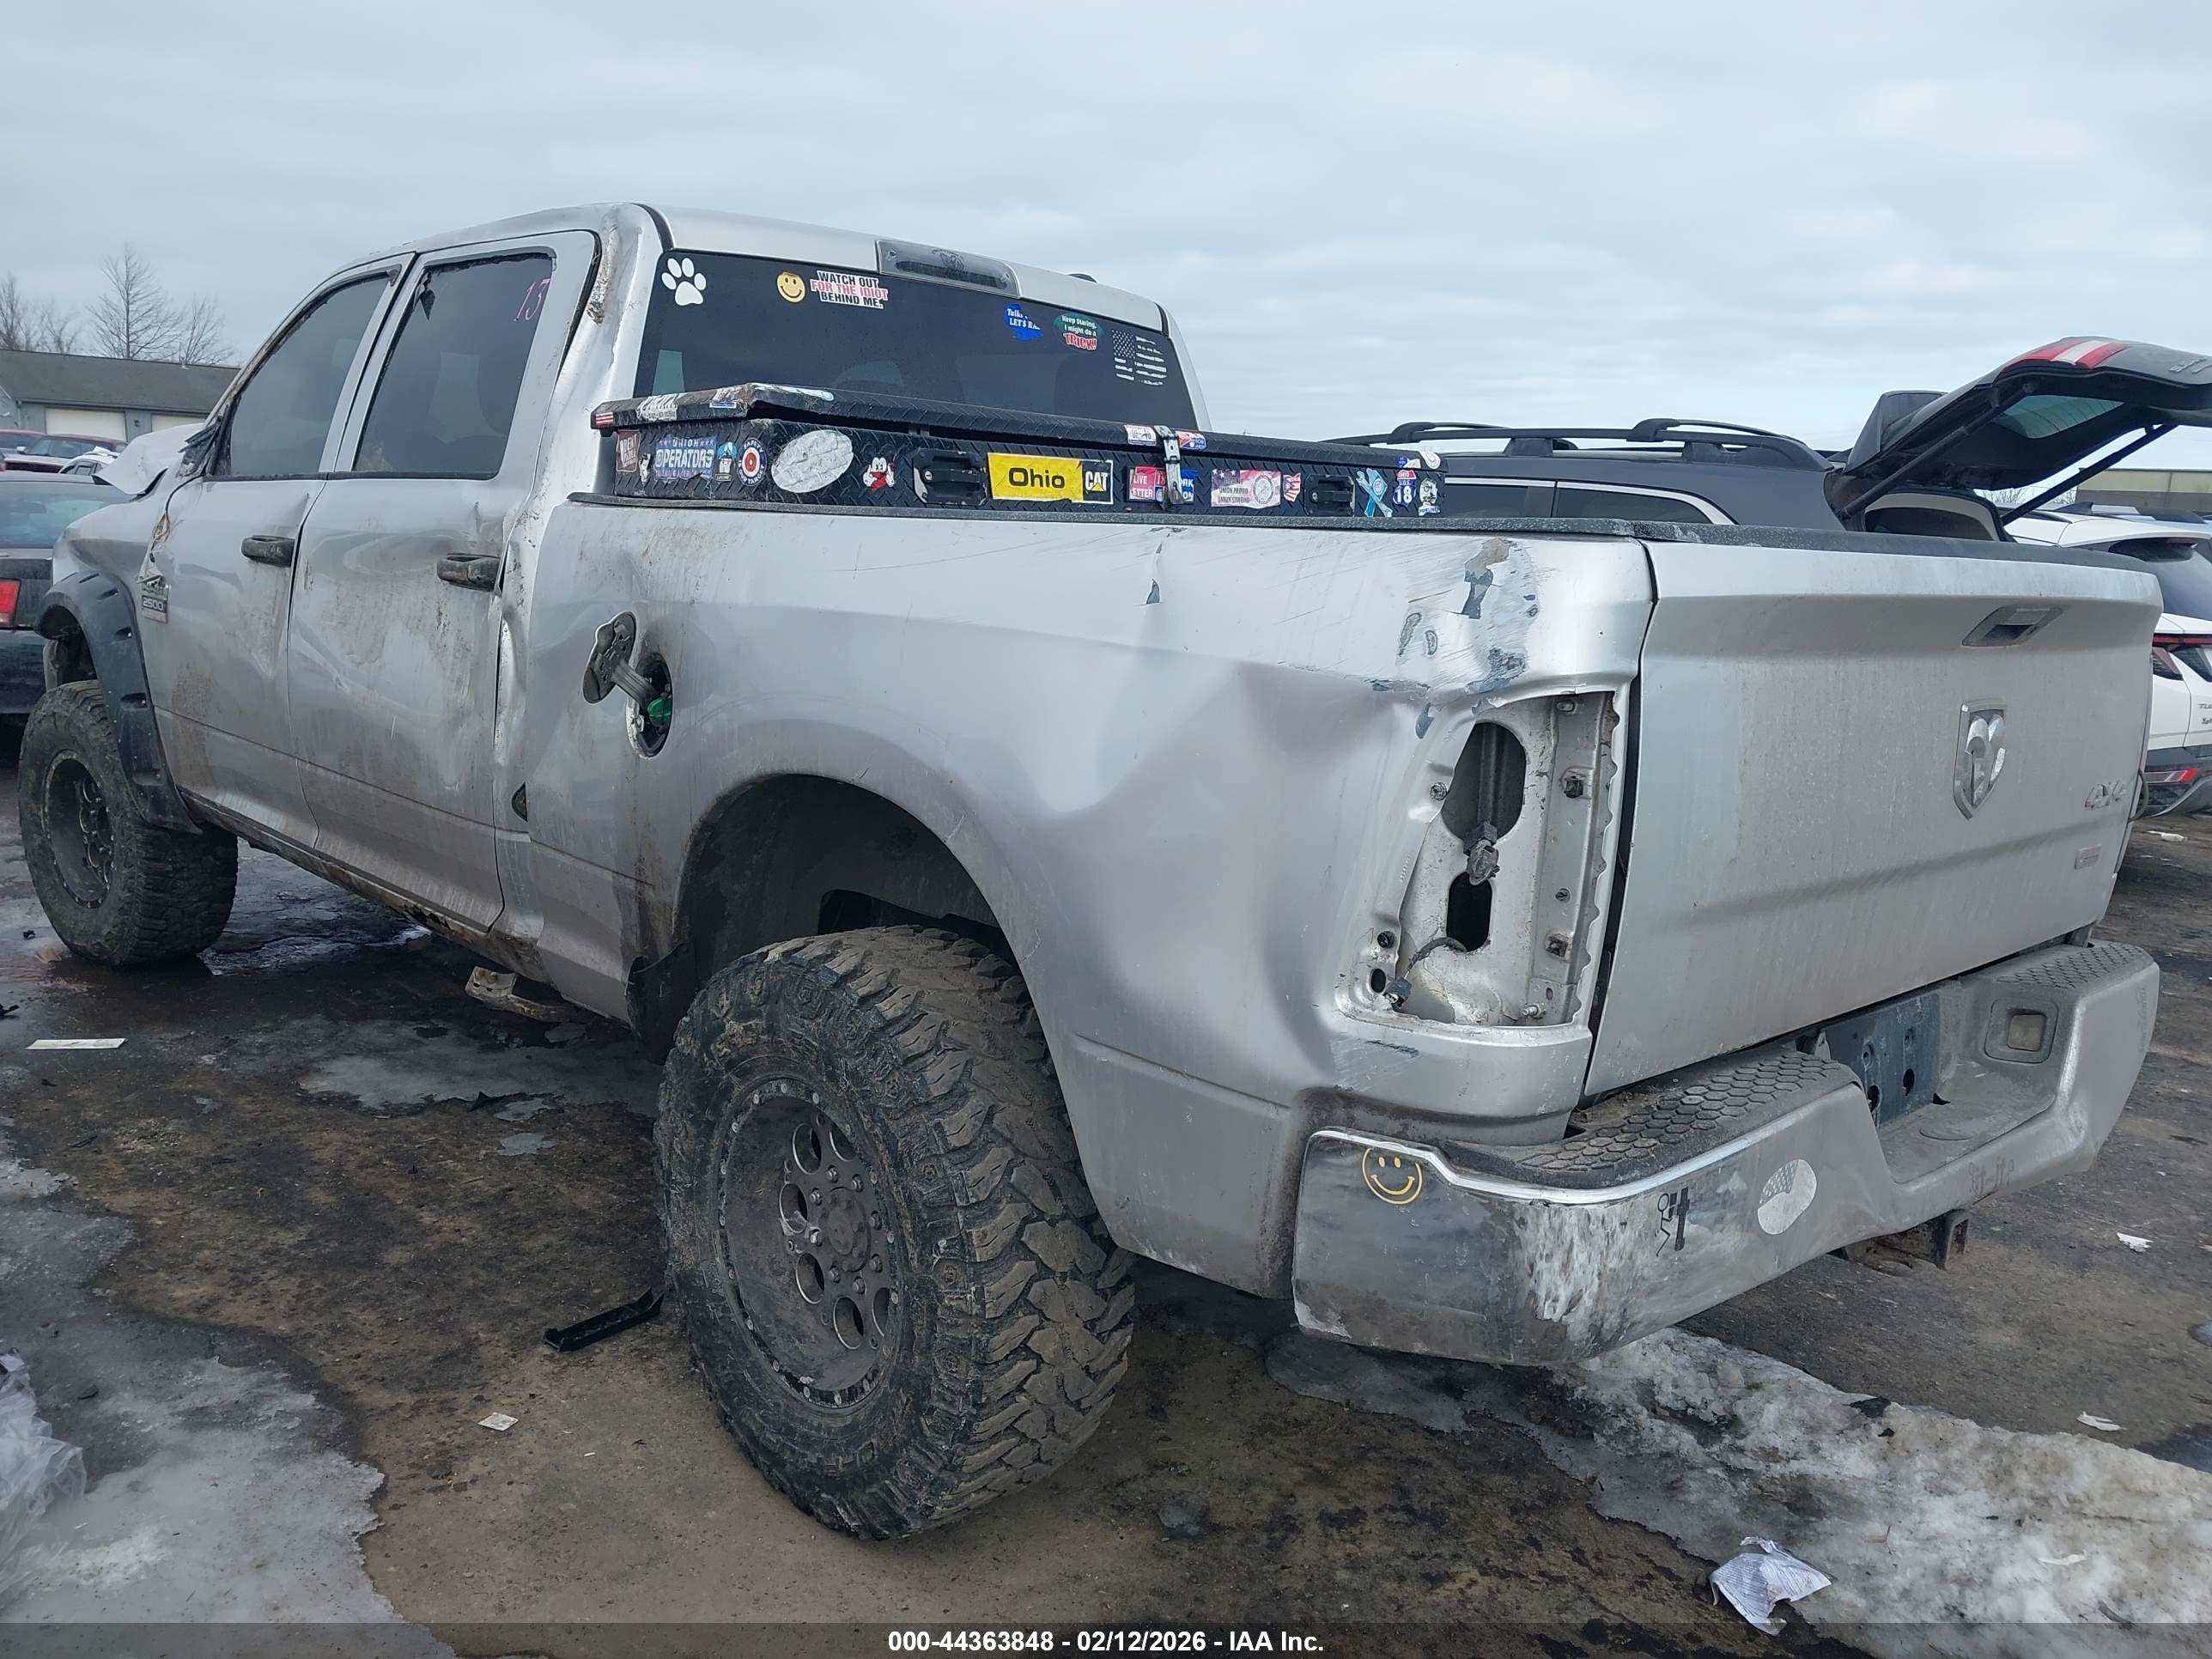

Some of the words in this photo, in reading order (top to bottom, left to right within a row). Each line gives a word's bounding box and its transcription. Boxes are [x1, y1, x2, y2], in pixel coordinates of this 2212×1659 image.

[817, 270, 856, 285] WATCH
[859, 277, 878, 289] OUT
[811, 280, 833, 292] FOR
[836, 283, 856, 295] THE
[860, 287, 888, 300] IDIOT
[821, 291, 860, 305] BEHIND
[863, 297, 883, 307] ME.
[1068, 325, 1084, 334] might
[672, 438, 700, 447] UNION
[744, 440, 763, 453] SAFETY
[654, 448, 714, 468] OPERATORS
[1008, 466, 1066, 489] Ohio
[1085, 471, 1108, 492] CAT
[1133, 474, 1148, 484] LIVE
[1395, 485, 1413, 504] 18
[143, 597, 164, 611] 2500
